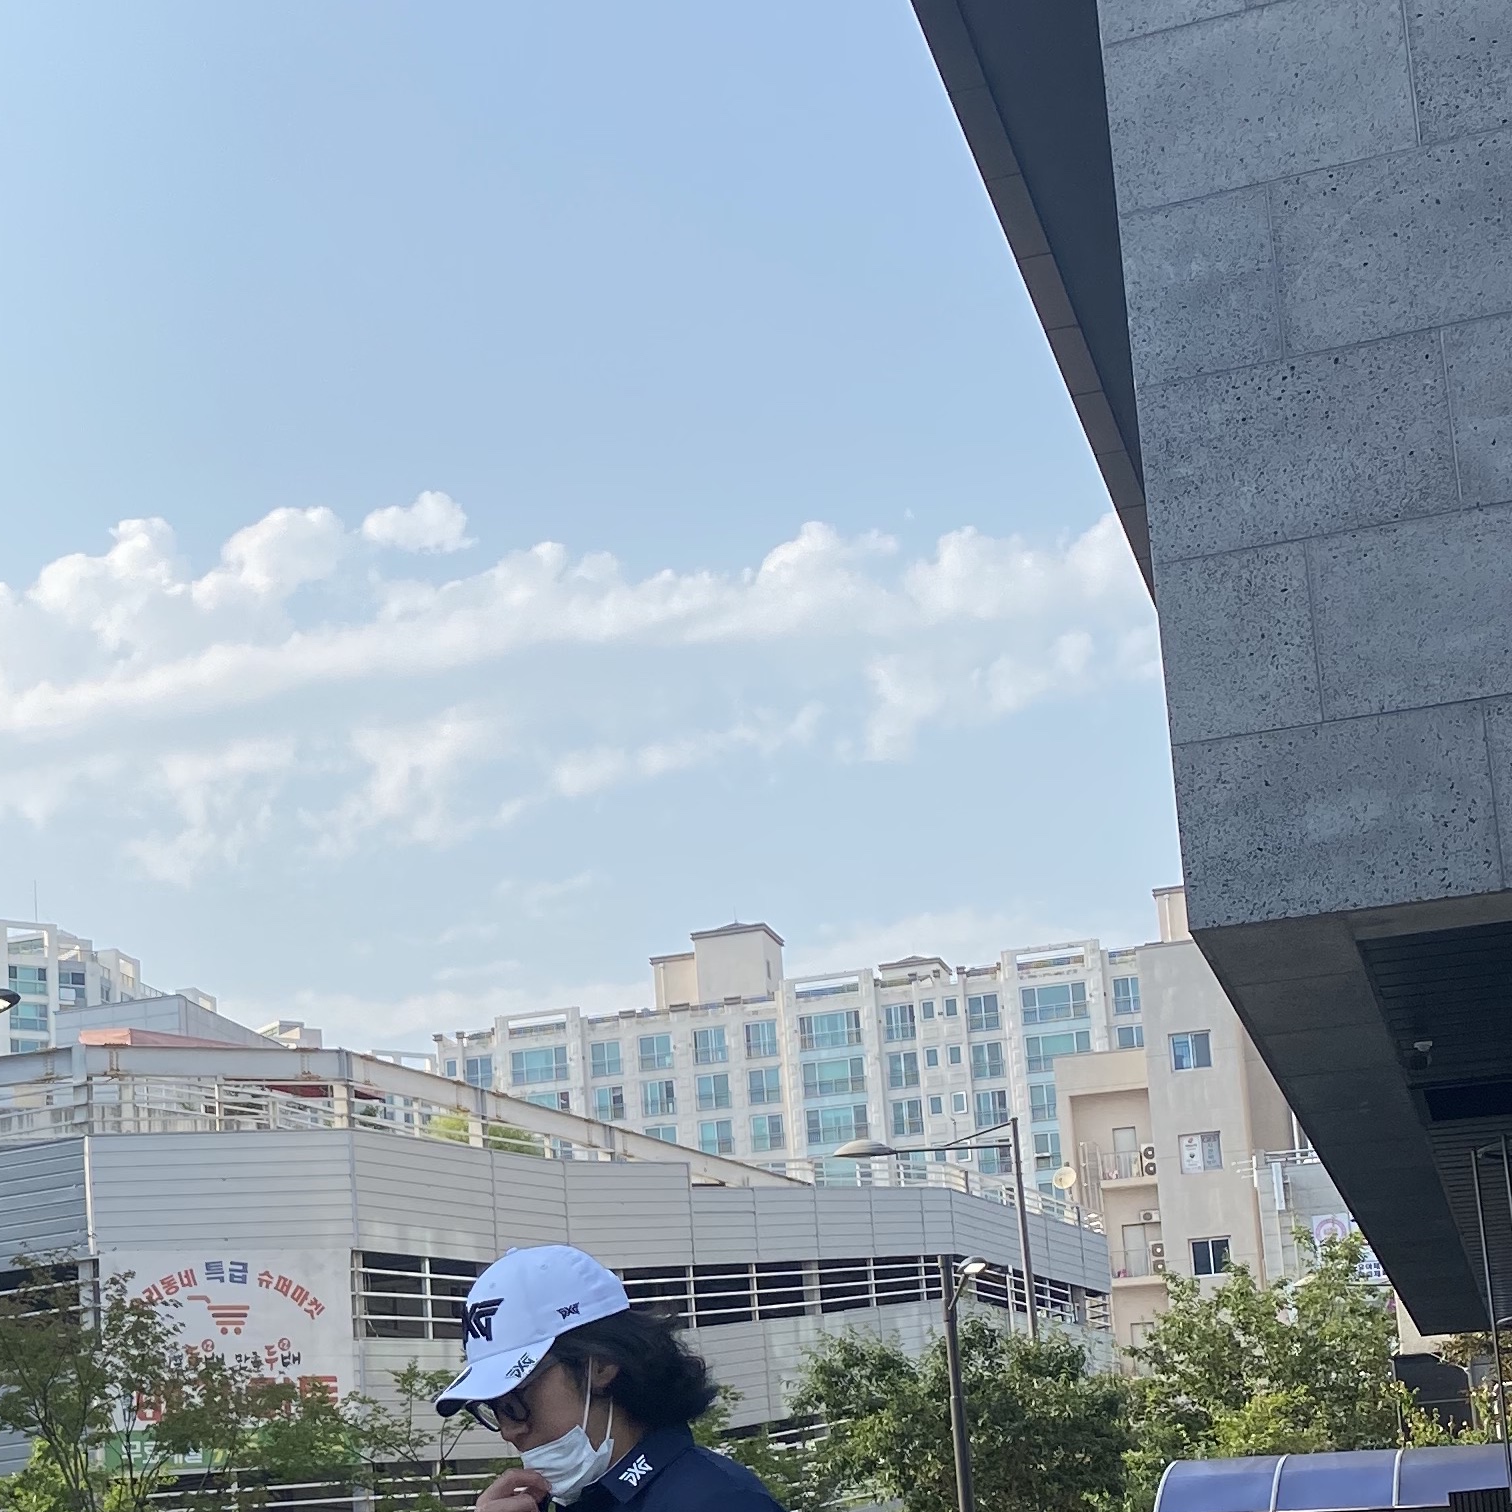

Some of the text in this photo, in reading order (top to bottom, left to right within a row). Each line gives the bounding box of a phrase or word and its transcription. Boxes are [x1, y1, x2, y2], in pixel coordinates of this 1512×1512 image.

[136, 1260, 326, 1320] 리동네 특급 슈퍼마켓
[505, 1352, 538, 1380] PXG
[618, 1454, 654, 1487] PXG
